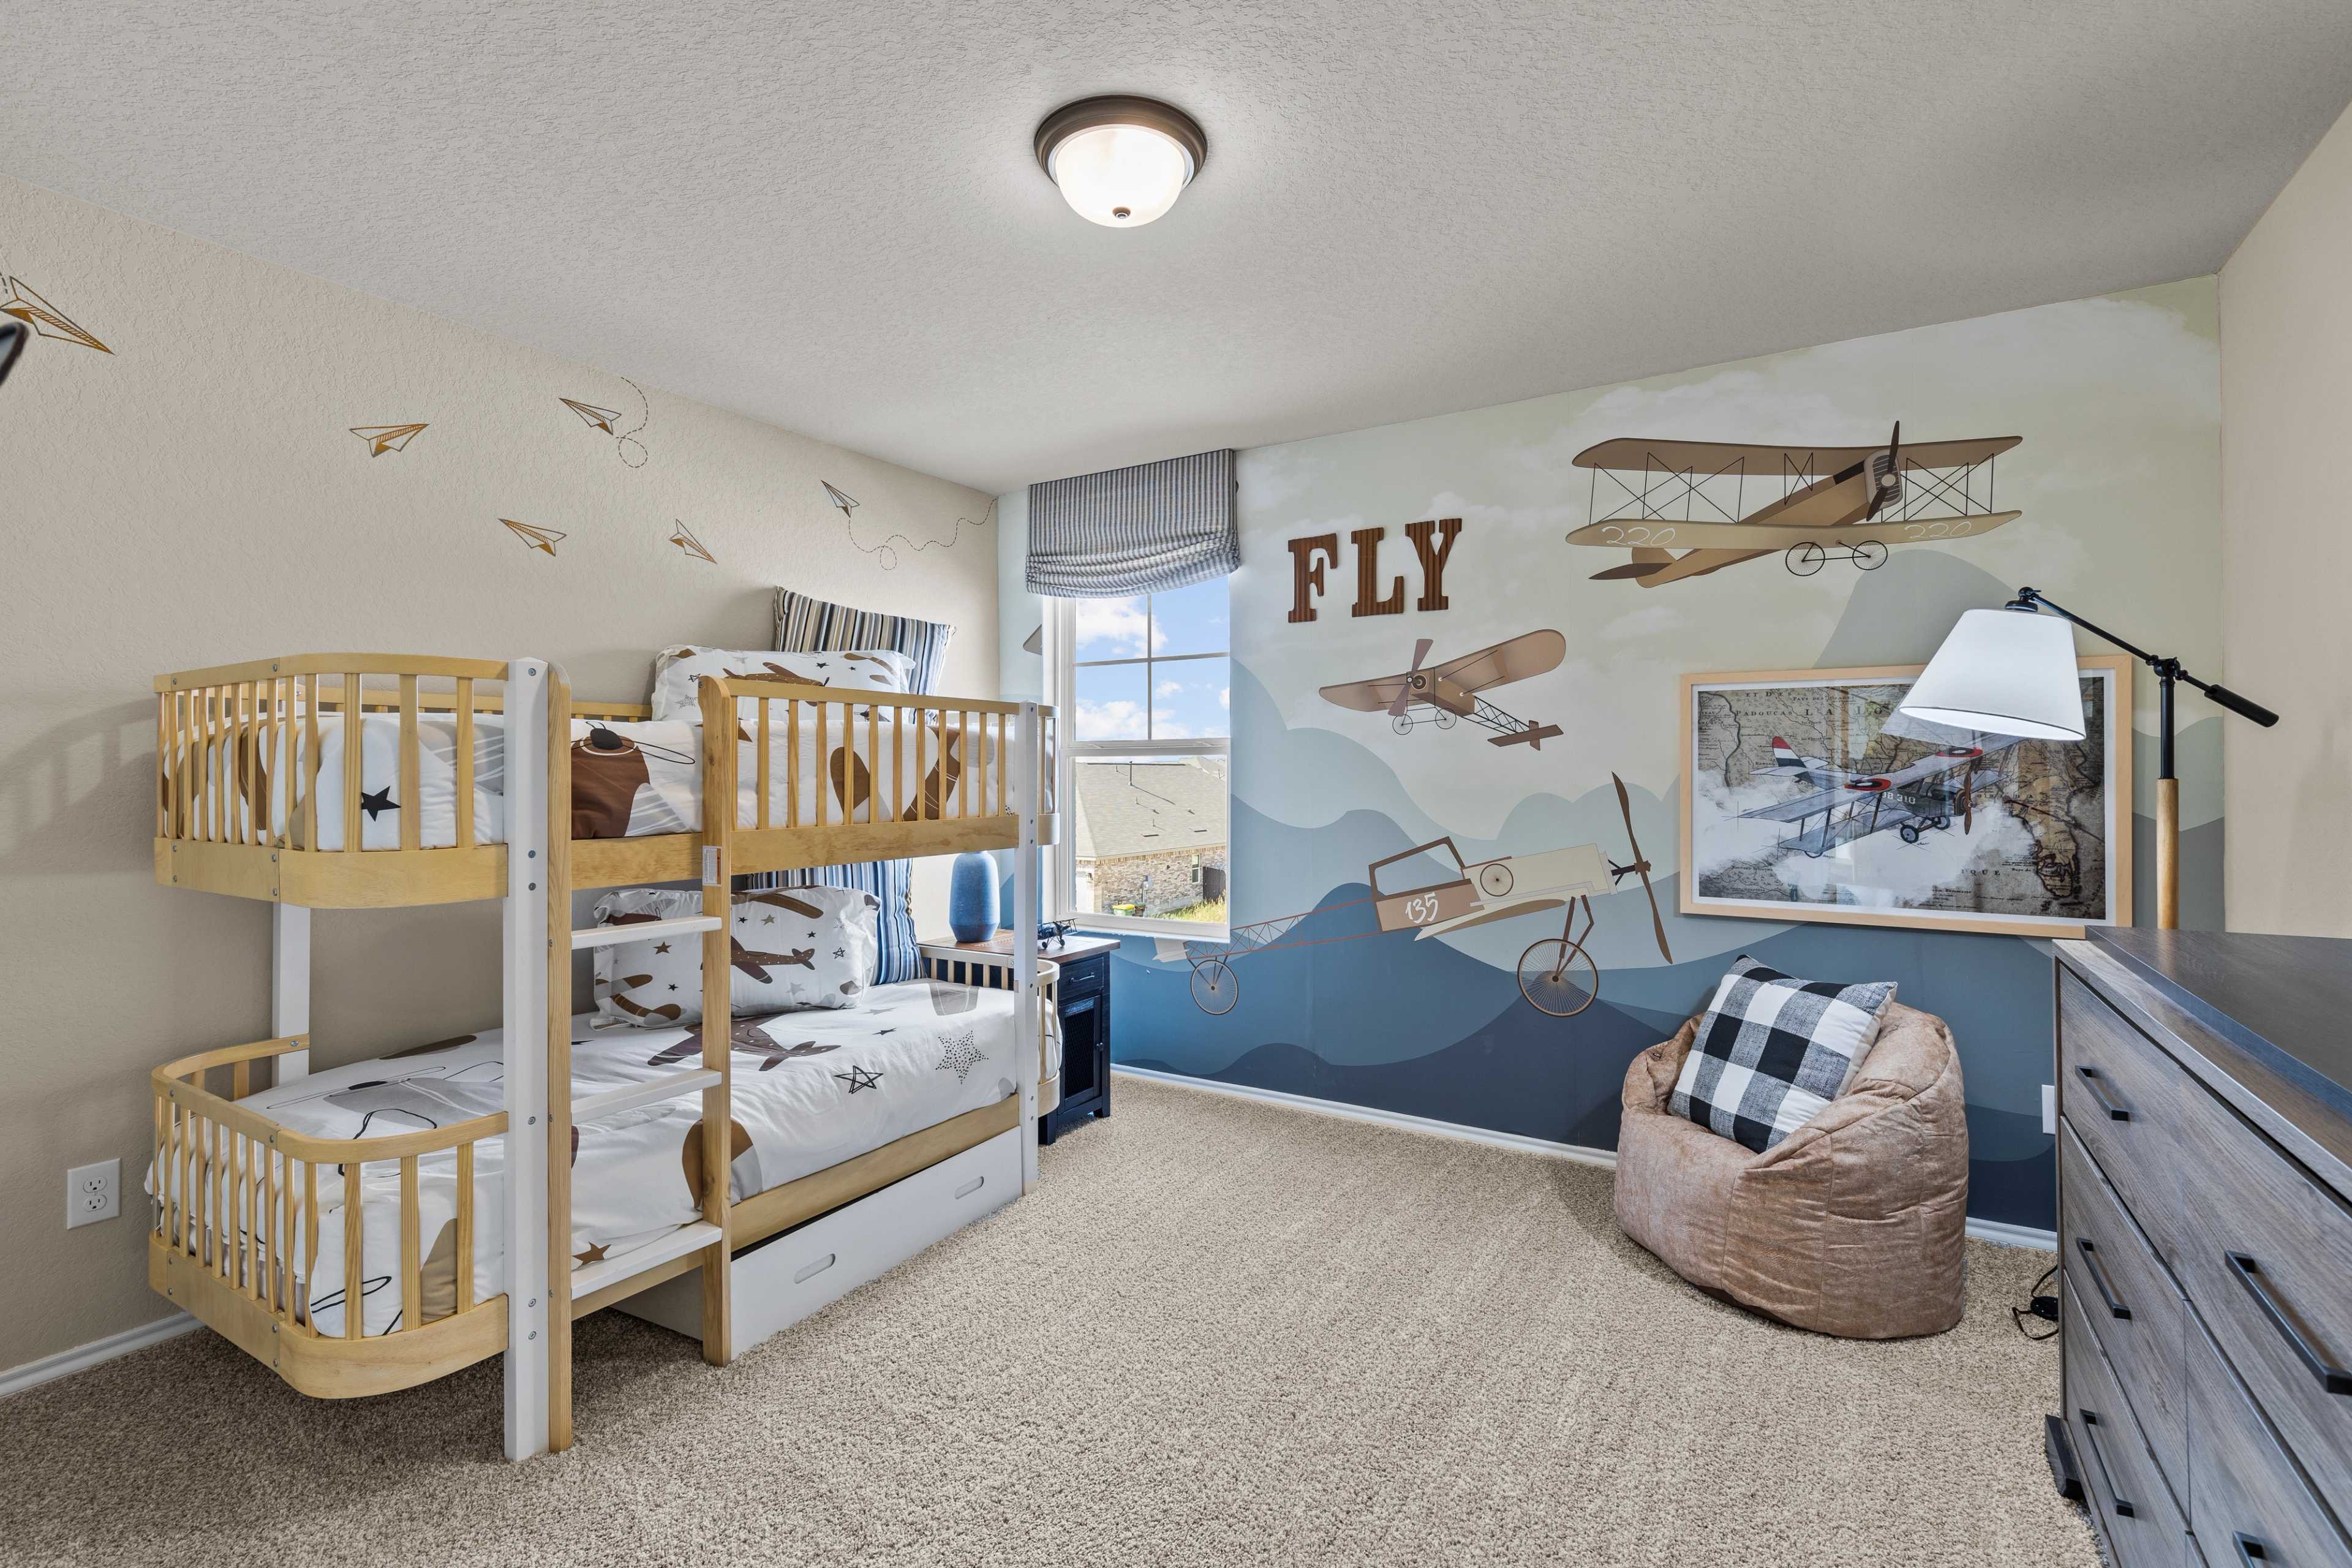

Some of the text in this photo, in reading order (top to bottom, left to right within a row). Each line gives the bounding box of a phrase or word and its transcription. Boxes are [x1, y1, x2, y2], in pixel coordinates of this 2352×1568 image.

[1602, 526, 1676, 546] 220
[1904, 521, 1972, 538] 220
[1287, 518, 1462, 623] FLY
[1896, 794, 1915, 804] 310
[1405, 892, 1438, 924] 135
